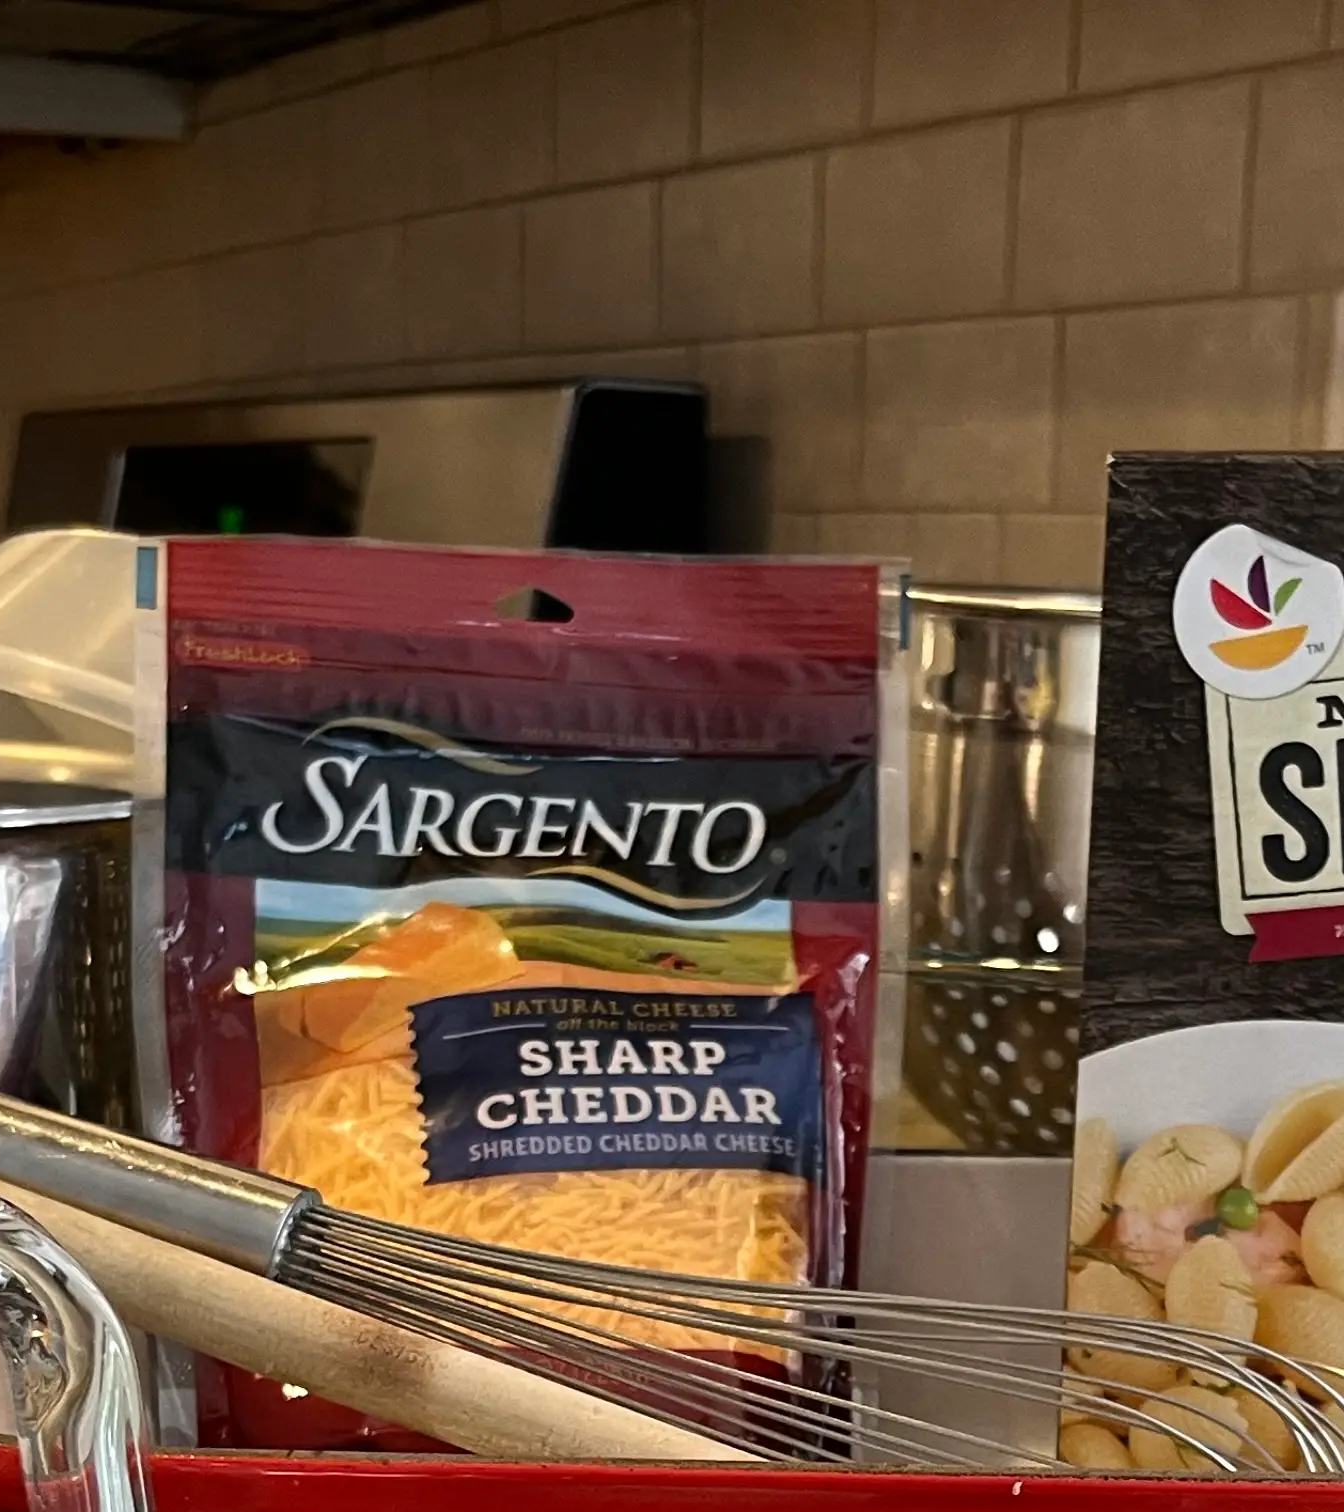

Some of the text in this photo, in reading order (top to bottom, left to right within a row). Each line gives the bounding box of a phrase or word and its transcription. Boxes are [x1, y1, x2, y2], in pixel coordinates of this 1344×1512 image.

[491, 998, 737, 1018] NATURAL CHEESE
[588, 1017, 619, 1031] the
[518, 1040, 726, 1076] SHARP
[476, 1085, 783, 1130] CHEDDAR
[468, 1132, 798, 1162] SHREDDED CHEDDAR CHEESE
